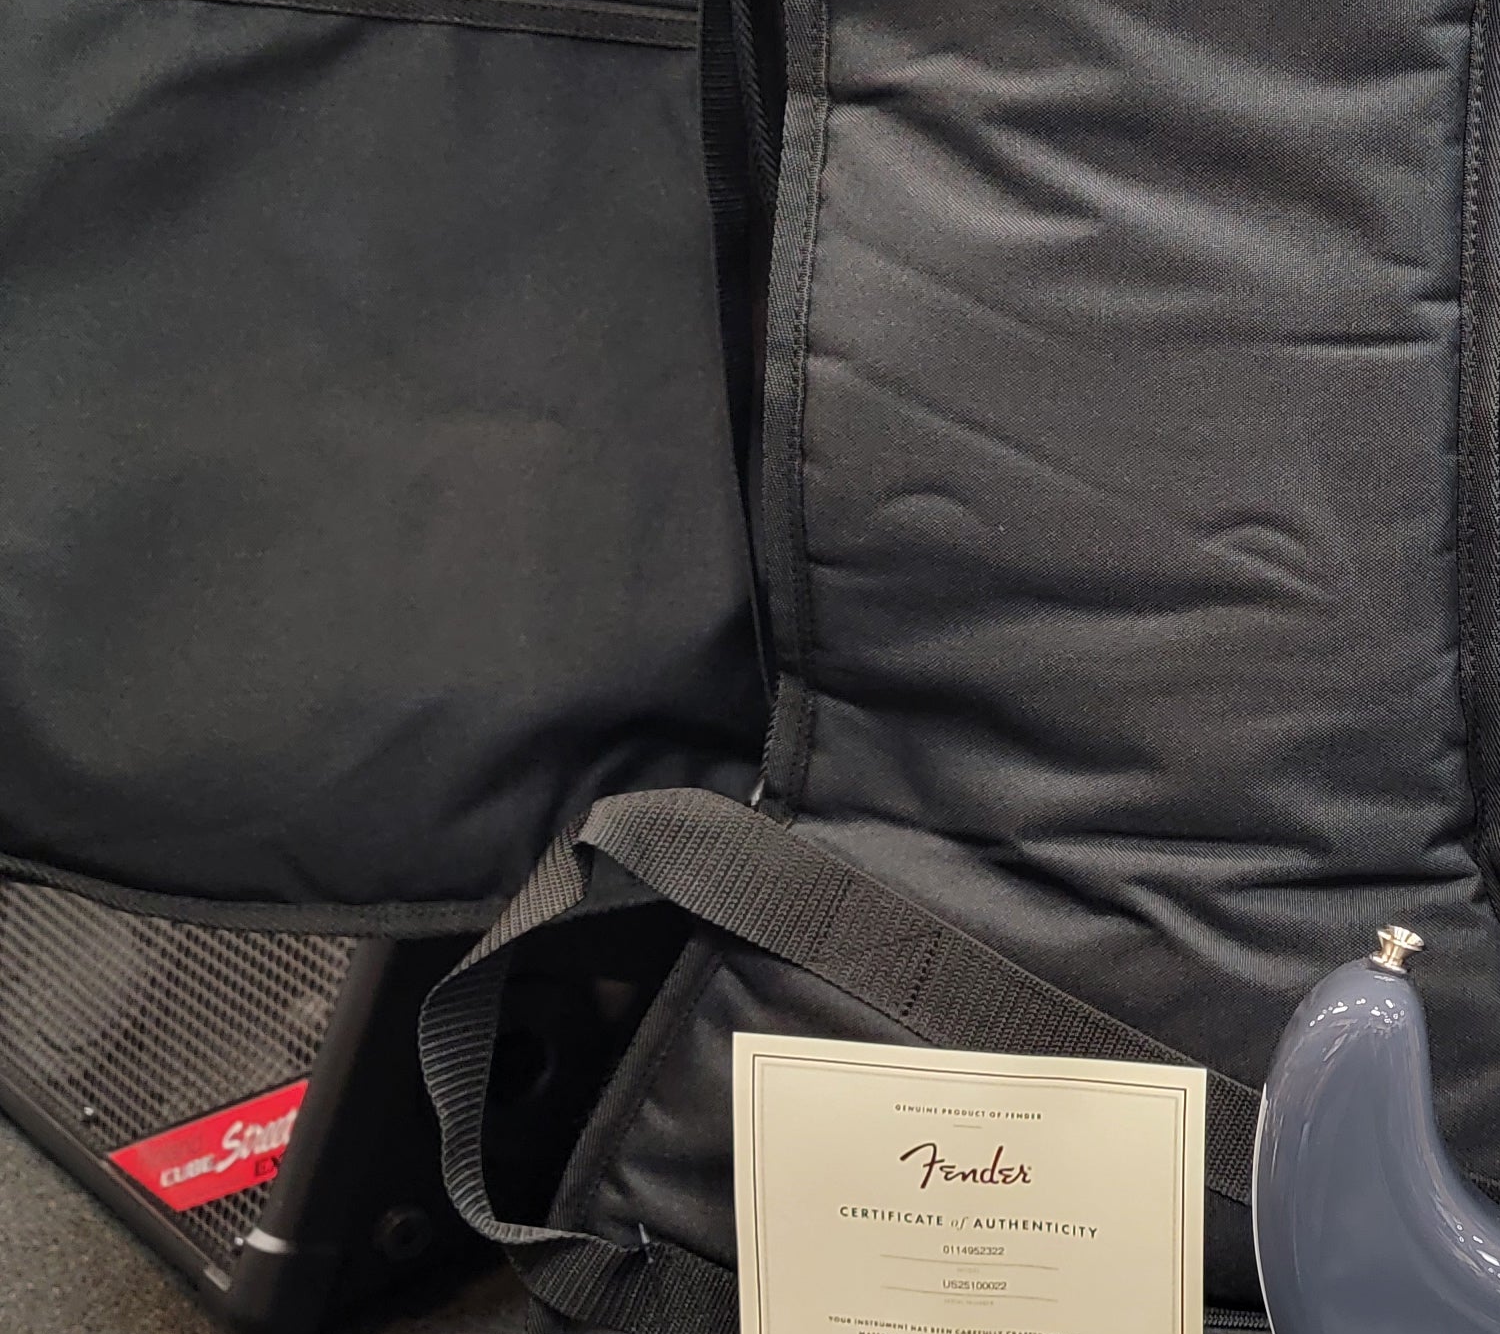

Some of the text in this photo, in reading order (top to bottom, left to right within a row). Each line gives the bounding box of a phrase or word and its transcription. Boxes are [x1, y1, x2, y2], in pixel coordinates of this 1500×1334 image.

[895, 1104, 938, 1115] GENUINE
[942, 1108, 986, 1118] PRODUCT
[989, 1111, 1001, 1119] OF
[899, 1142, 1032, 1189] Fender
[839, 1205, 1098, 1239] CERTIFICATE of AUTHENTICITY
[828, 1316, 851, 1324] YOUR
[854, 1318, 908, 1330] INSTRUMENT
[911, 1325, 927, 1333] HAS
[930, 1327, 952, 1334] BEEN
